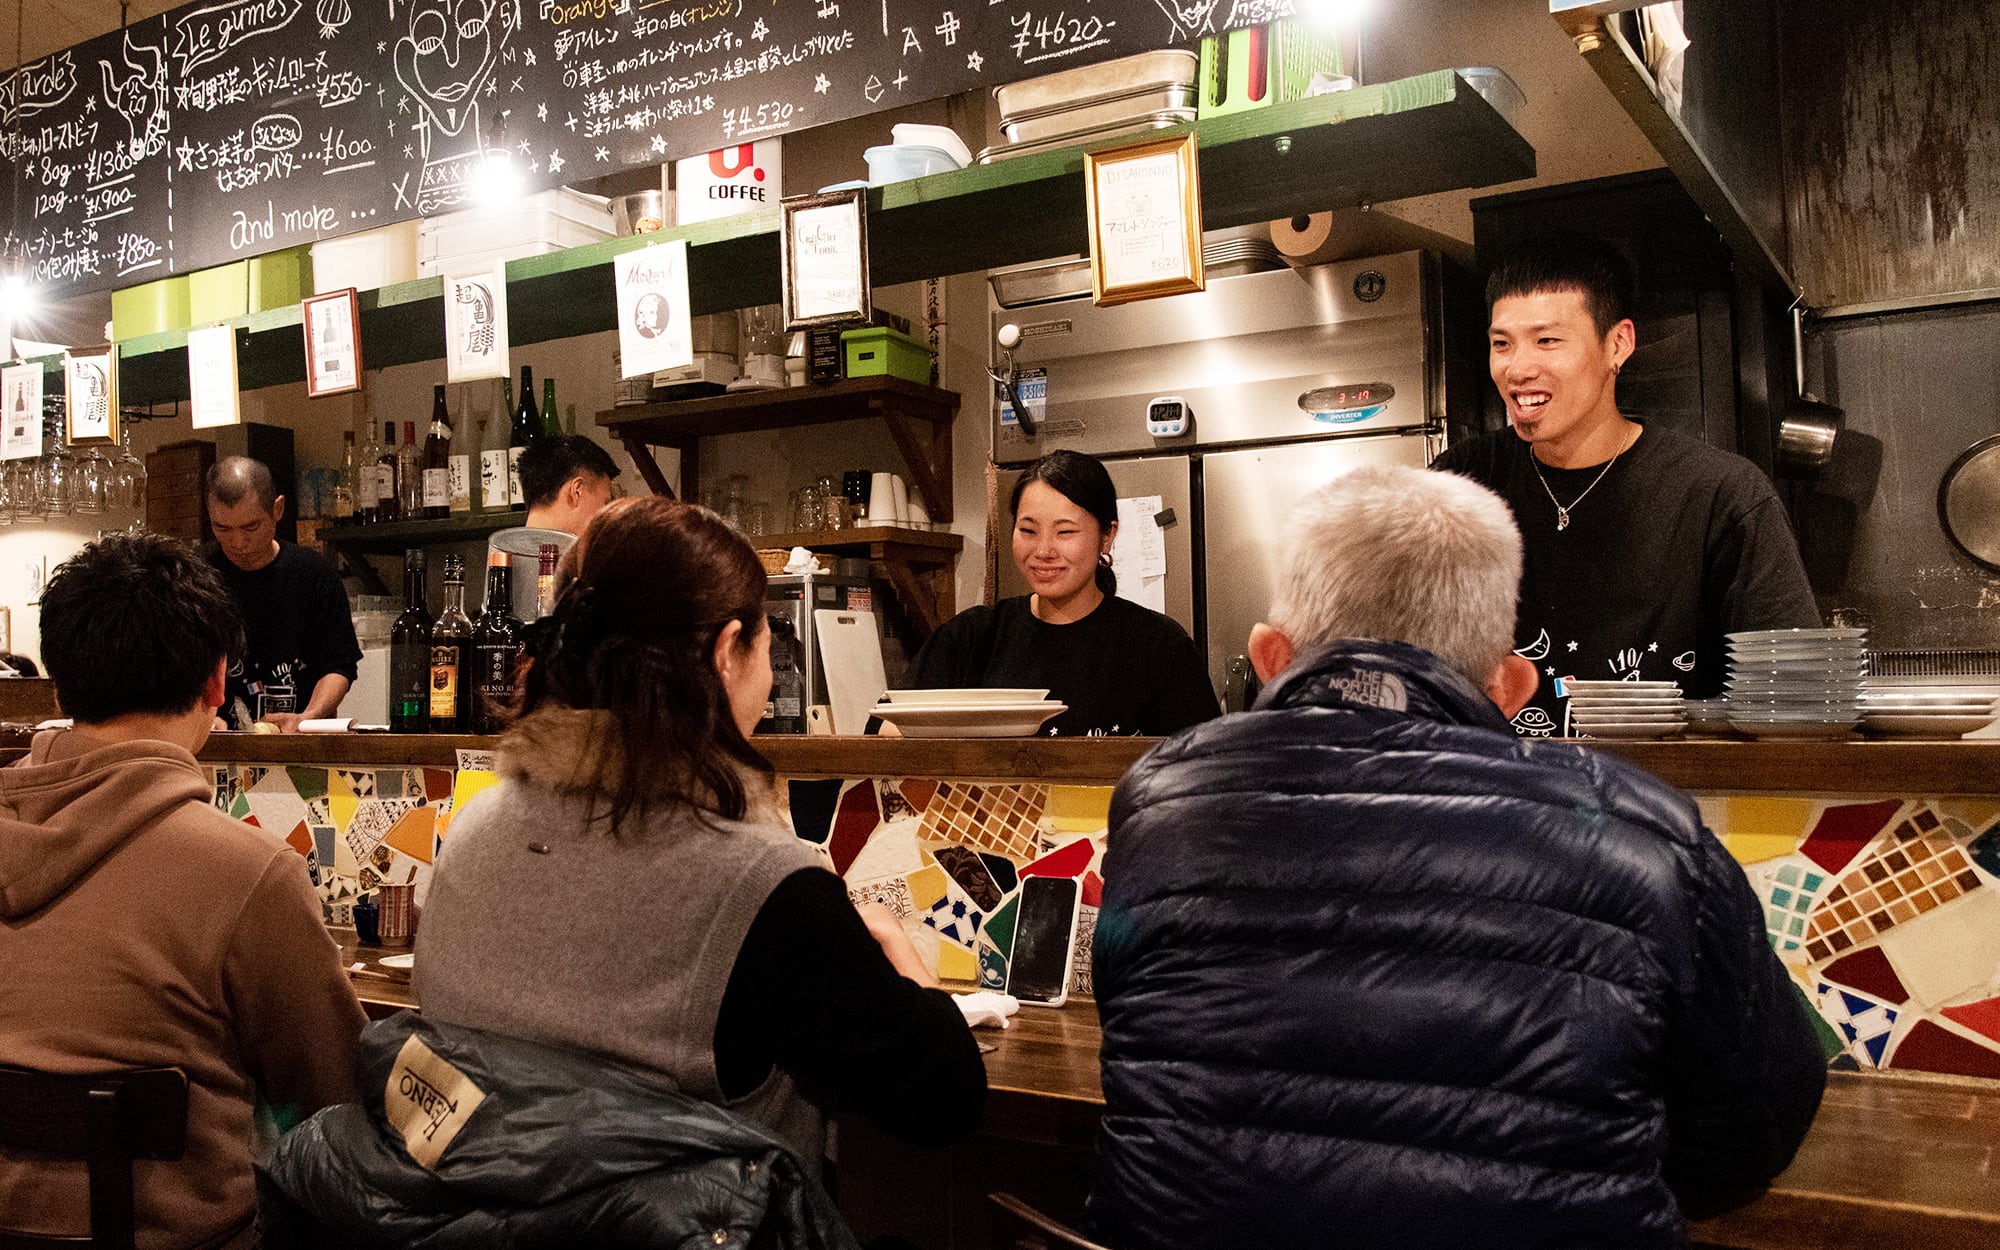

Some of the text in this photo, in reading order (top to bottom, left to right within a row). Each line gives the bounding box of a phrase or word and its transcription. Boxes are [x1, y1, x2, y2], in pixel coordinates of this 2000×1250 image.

[709, 184, 766, 203] COFFEE
[230, 200, 274, 250] and
[281, 204, 340, 241] more
[1328, 411, 1363, 421] INVERTER
[1352, 667, 1381, 683] THE
[1328, 678, 1381, 695] NORTH
[1341, 689, 1379, 707] FACE
